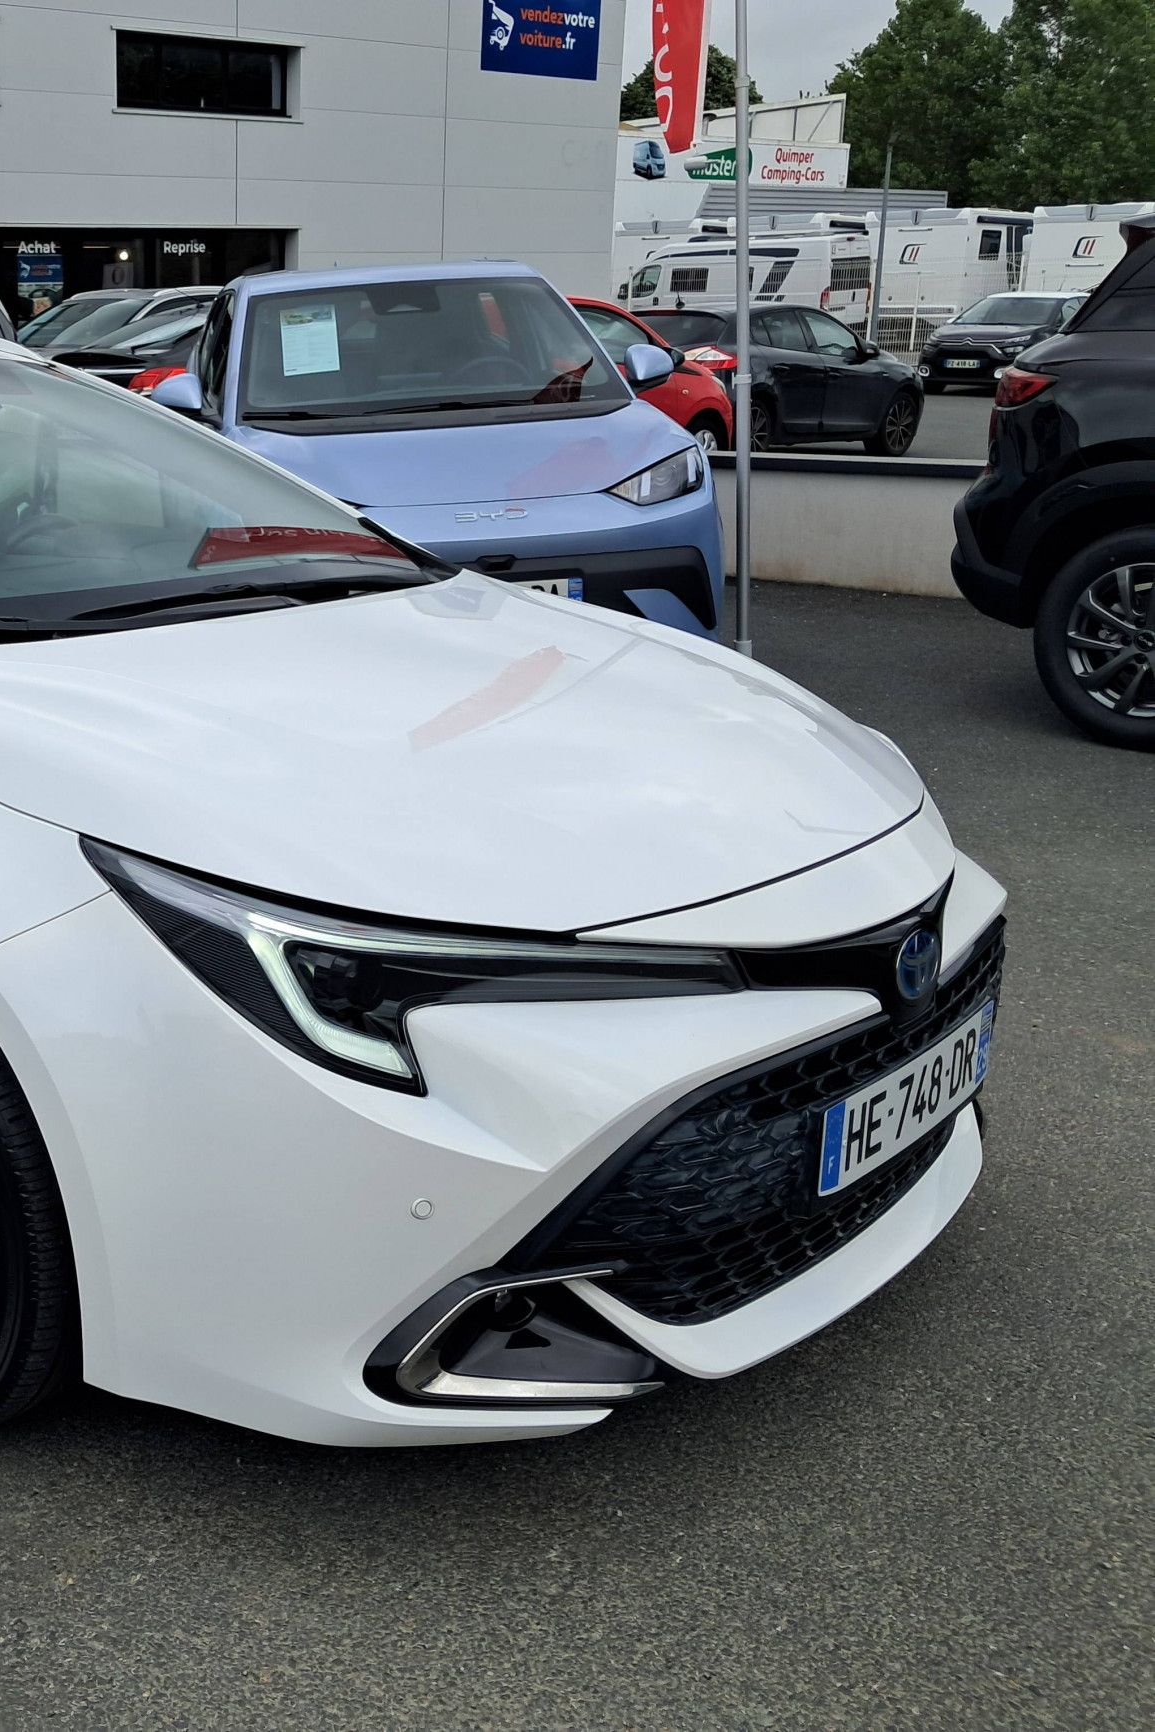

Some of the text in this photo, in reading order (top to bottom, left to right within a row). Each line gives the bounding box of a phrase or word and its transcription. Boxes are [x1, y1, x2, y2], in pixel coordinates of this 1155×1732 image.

[520, 5, 596, 28] vendezvotre
[519, 29, 576, 50] voiture.fr
[775, 147, 814, 167] Quimper
[760, 165, 825, 184] Camping-Cars
[18, 240, 56, 254] Achat
[163, 240, 206, 256] Reprise
[454, 508, 528, 524] BYD
[845, 1028, 977, 1173] HE-748-DR
